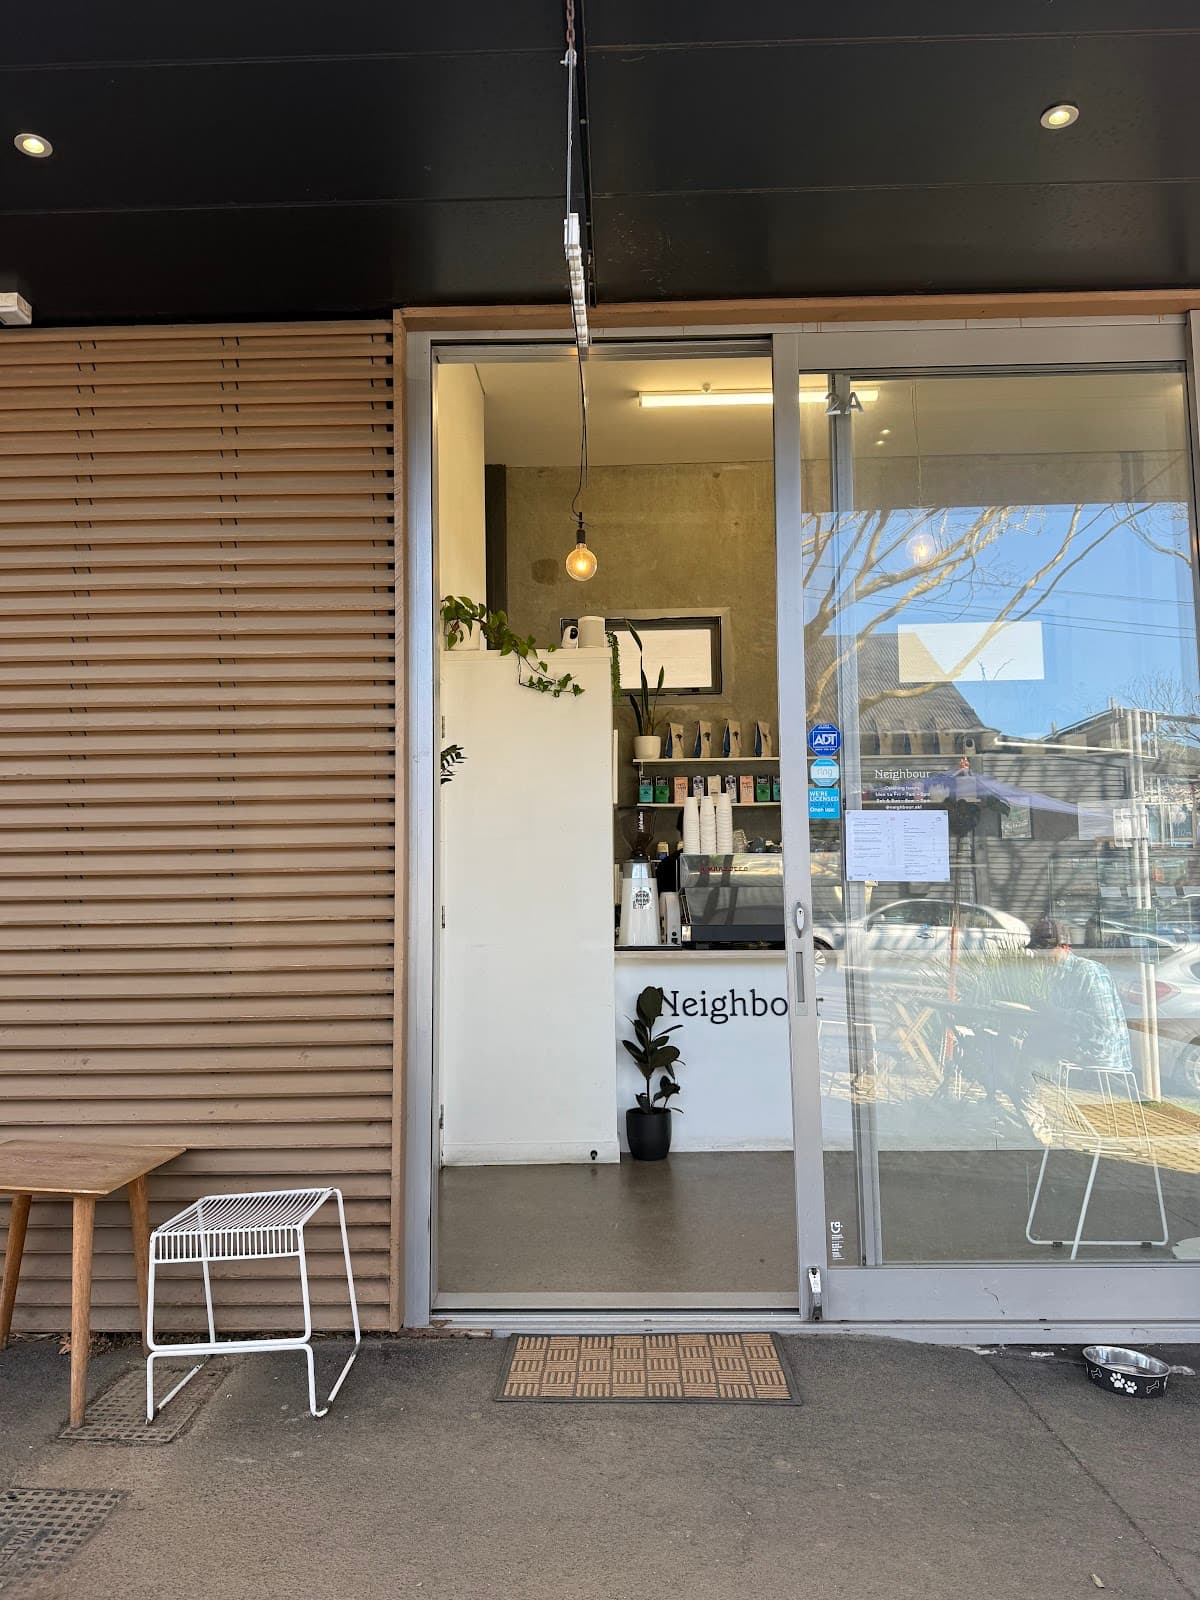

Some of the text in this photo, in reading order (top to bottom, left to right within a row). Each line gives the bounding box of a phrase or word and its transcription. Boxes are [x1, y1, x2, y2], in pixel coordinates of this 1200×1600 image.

[825, 392, 864, 415] 2A
[814, 733, 836, 745] ADT
[874, 769, 930, 780] Neighbour
[660, 988, 824, 1025] Neighbor
